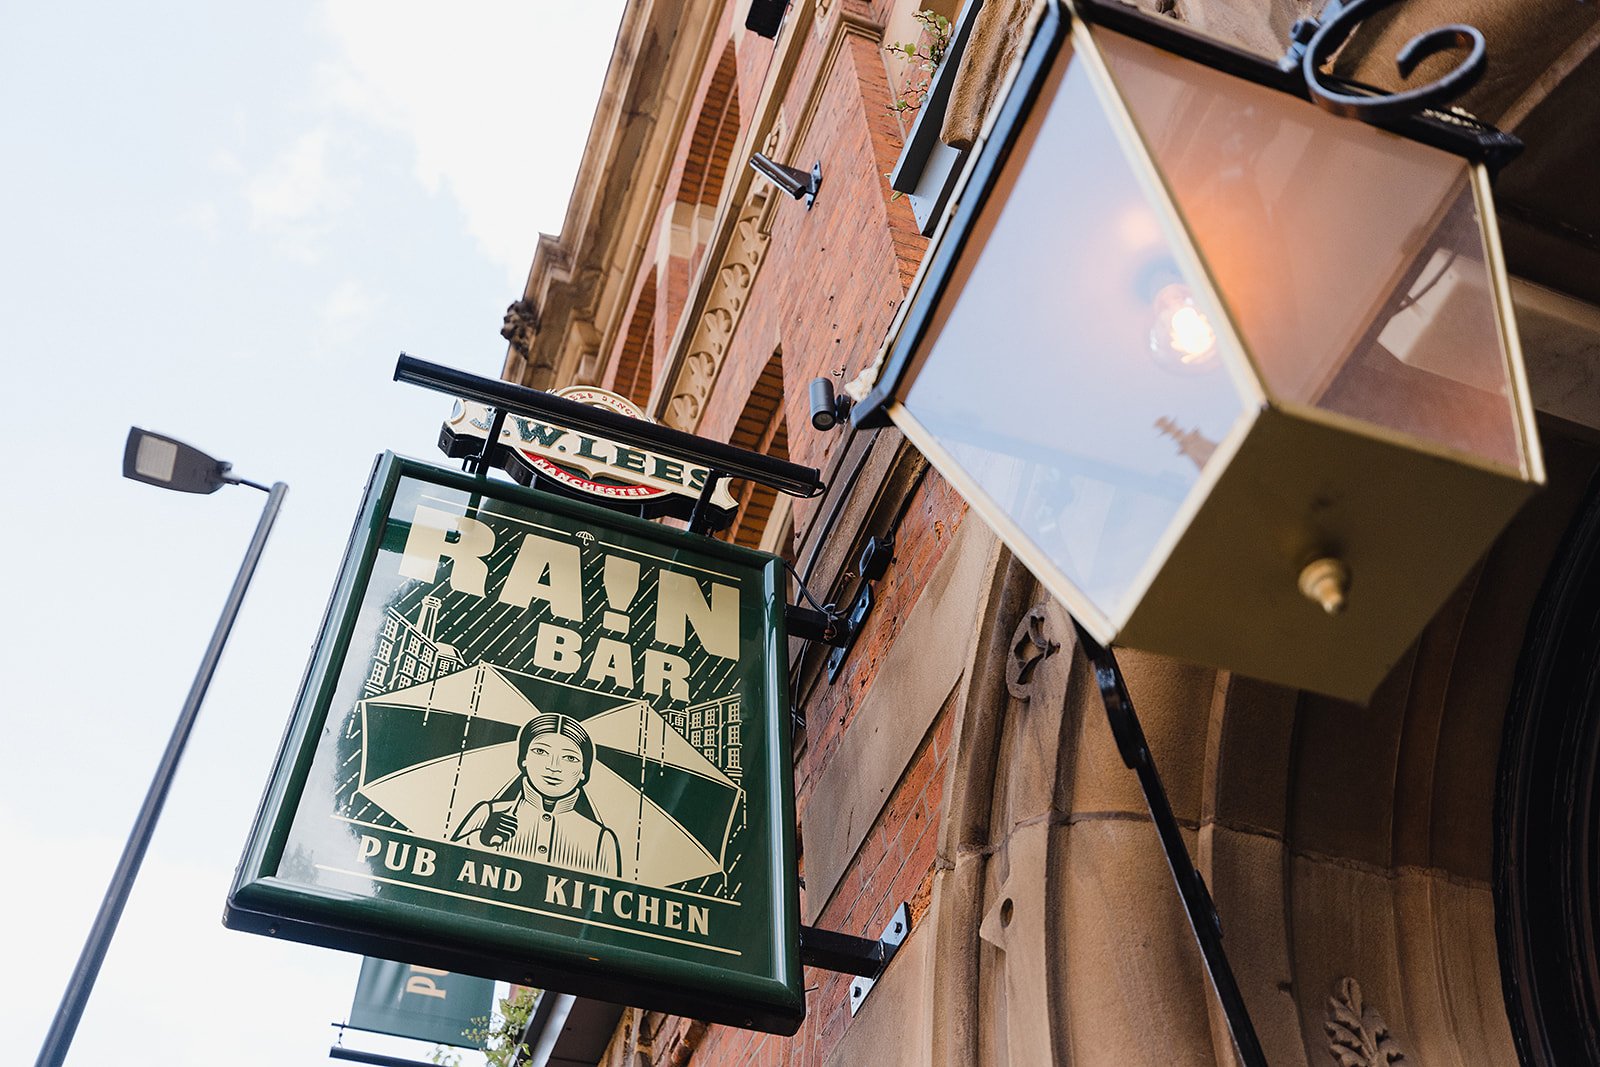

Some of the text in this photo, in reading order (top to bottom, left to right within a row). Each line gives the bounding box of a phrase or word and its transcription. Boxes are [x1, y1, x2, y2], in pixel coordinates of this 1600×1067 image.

[534, 458, 650, 497] MANCHESTER
[399, 505, 741, 662] RA!N
[533, 622, 691, 701] BAR
[356, 834, 711, 936] PUB AND KITCHEN
